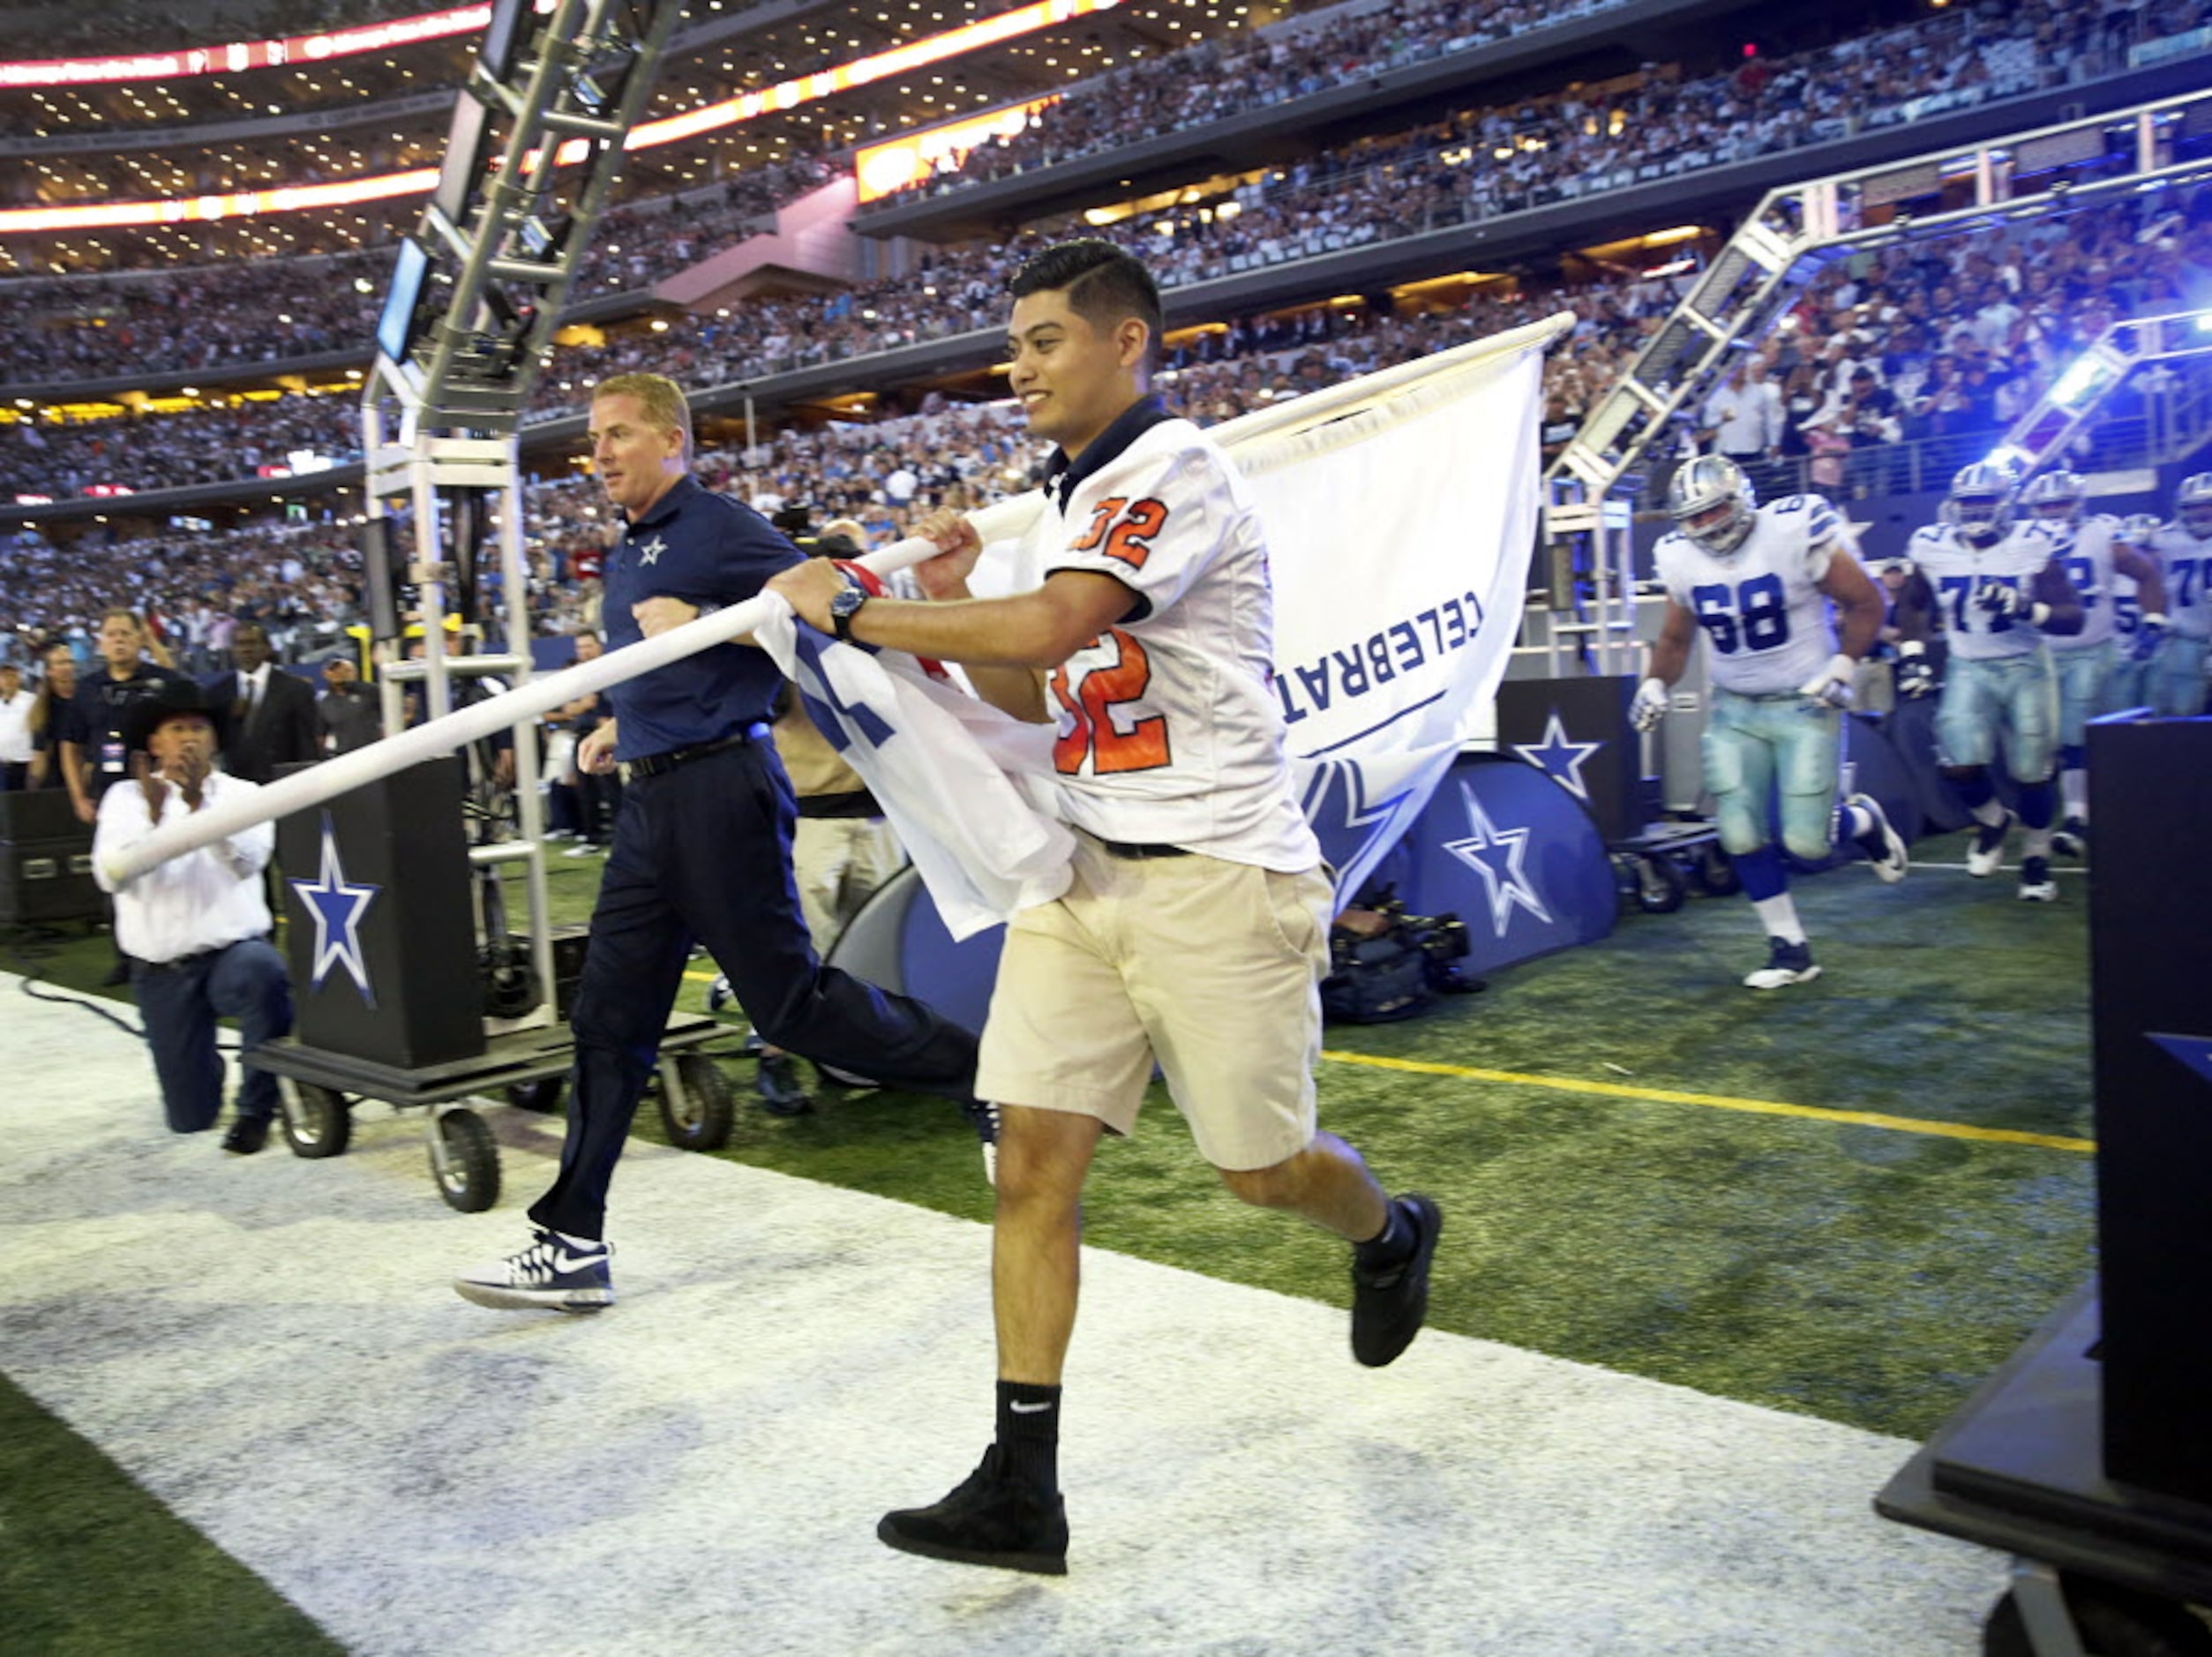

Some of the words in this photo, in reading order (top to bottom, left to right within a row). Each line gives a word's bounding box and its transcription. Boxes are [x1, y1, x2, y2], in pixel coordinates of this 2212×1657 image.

[1066, 496, 1169, 571] 32
[1691, 572, 1790, 655] 68
[1274, 590, 1484, 724] CELEBRAT
